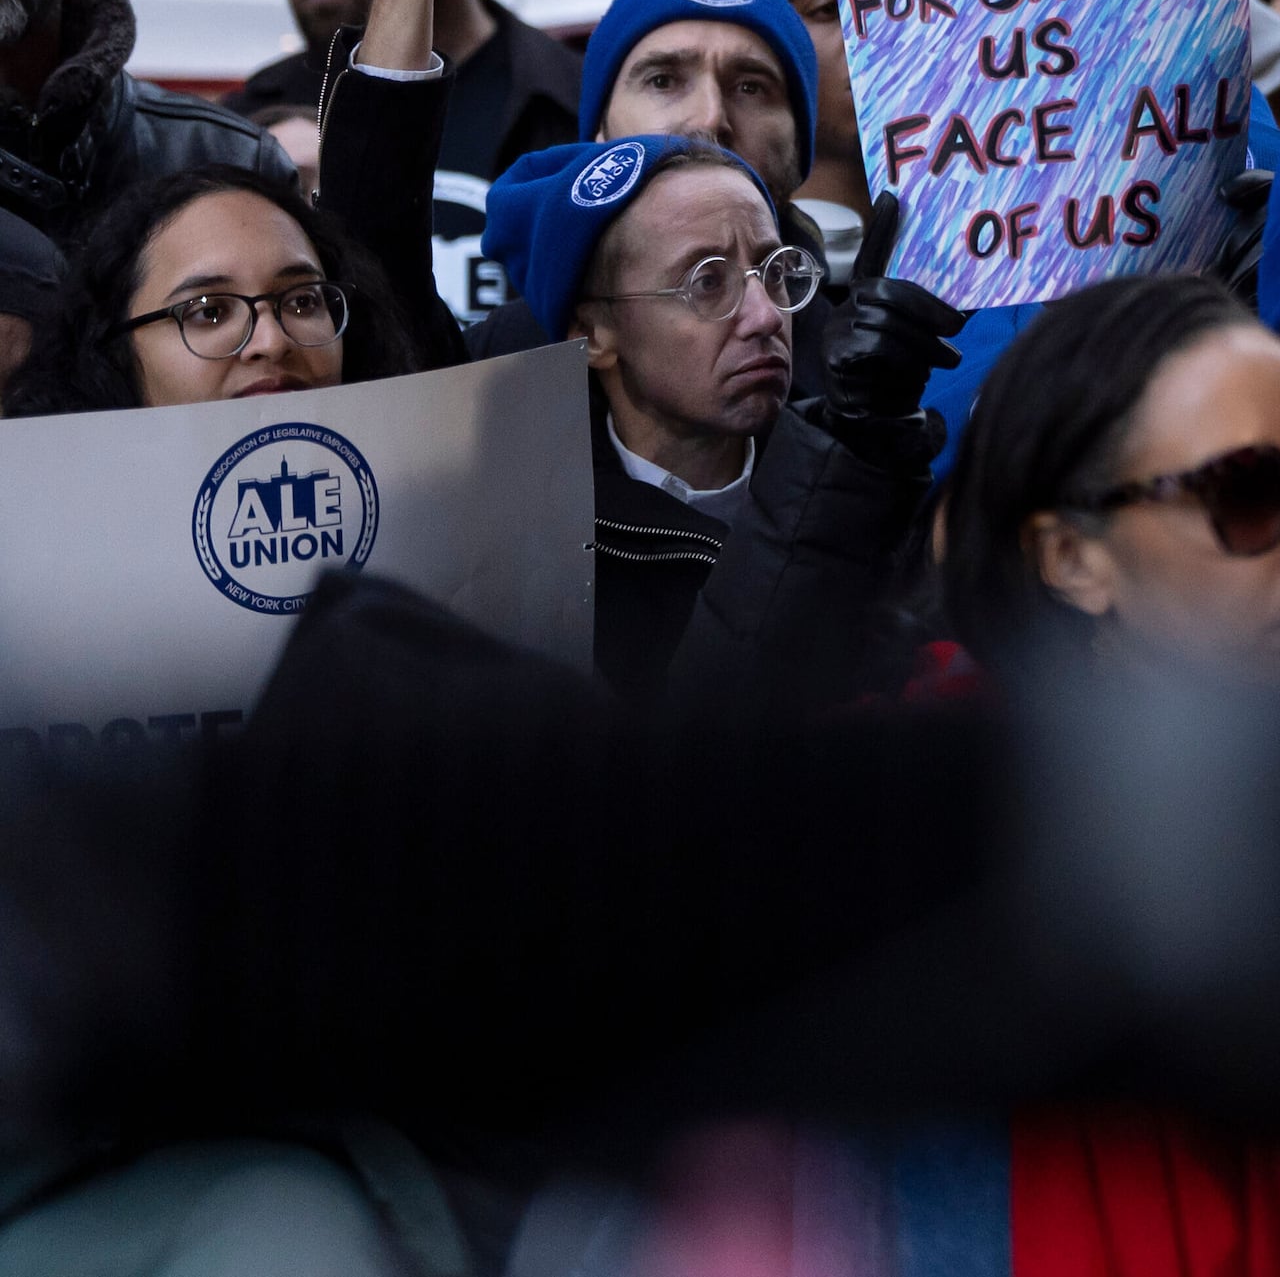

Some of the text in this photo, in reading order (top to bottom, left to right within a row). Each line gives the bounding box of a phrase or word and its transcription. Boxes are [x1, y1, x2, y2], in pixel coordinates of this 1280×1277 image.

[977, 17, 1080, 82] US
[882, 78, 1242, 187] FACE ALL
[585, 154, 624, 195] ALE
[592, 156, 635, 198] UNION
[965, 178, 1162, 261] OF US
[211, 428, 361, 485] ASSOCIATION OF LEGISLATIVE EMPLOYEES
[227, 475, 342, 539] ALE
[229, 529, 344, 569] UNION
[224, 581, 251, 602] NEW
[251, 595, 281, 611] YORK
